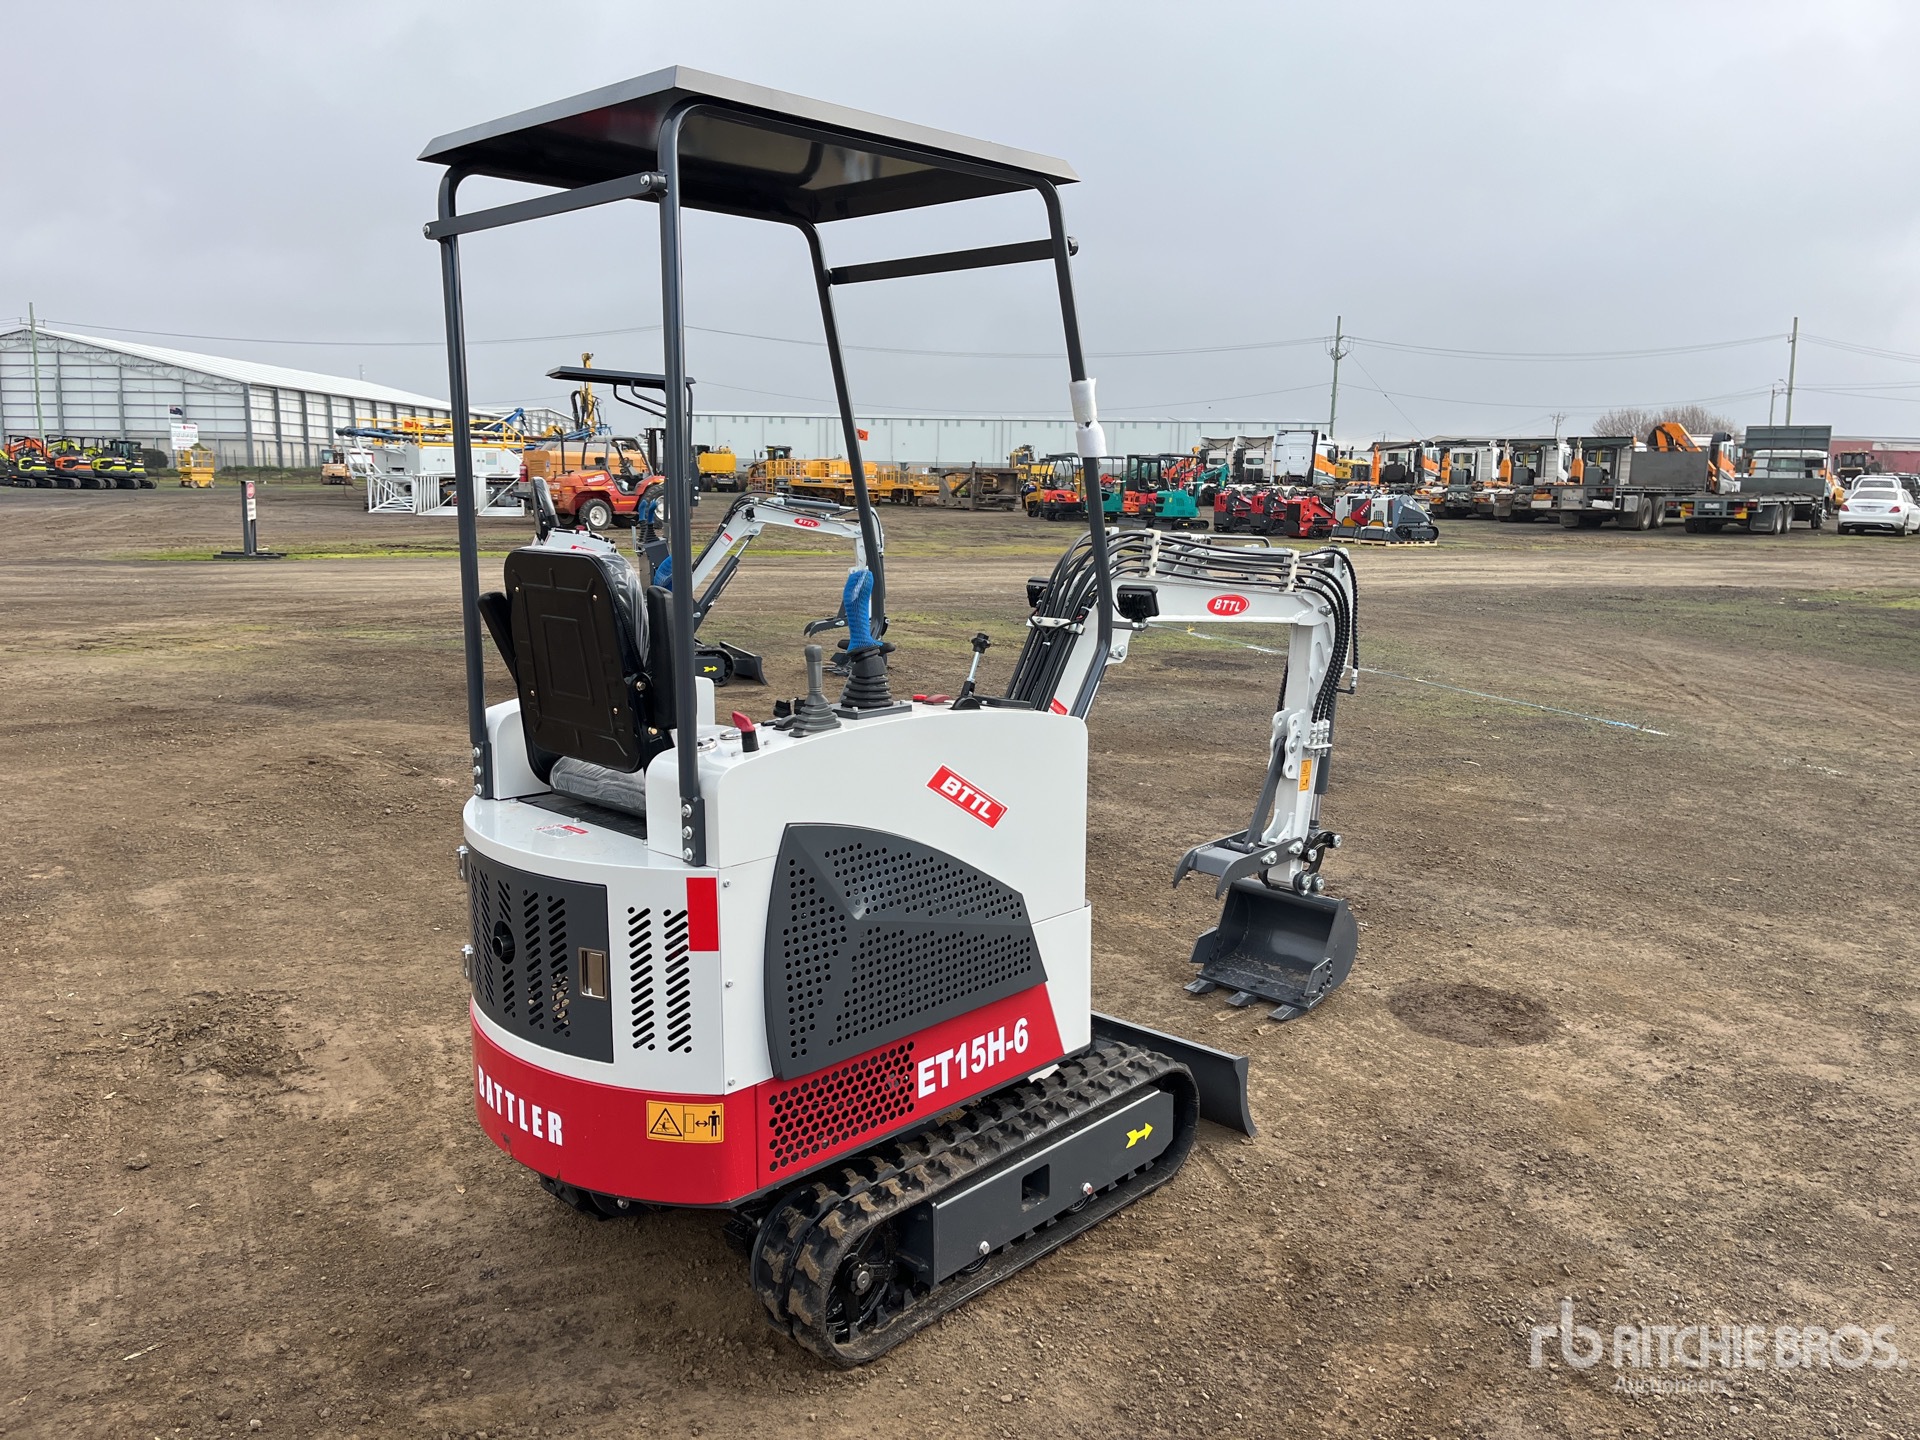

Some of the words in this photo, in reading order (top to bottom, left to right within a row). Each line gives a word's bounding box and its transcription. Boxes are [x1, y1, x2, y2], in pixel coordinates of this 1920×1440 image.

[798, 518, 815, 527] BTTL
[1213, 598, 1240, 613] BTTL
[940, 775, 992, 819] BTTL
[917, 1017, 1029, 1099] ET15H-6
[477, 1064, 563, 1147] BATTLER
